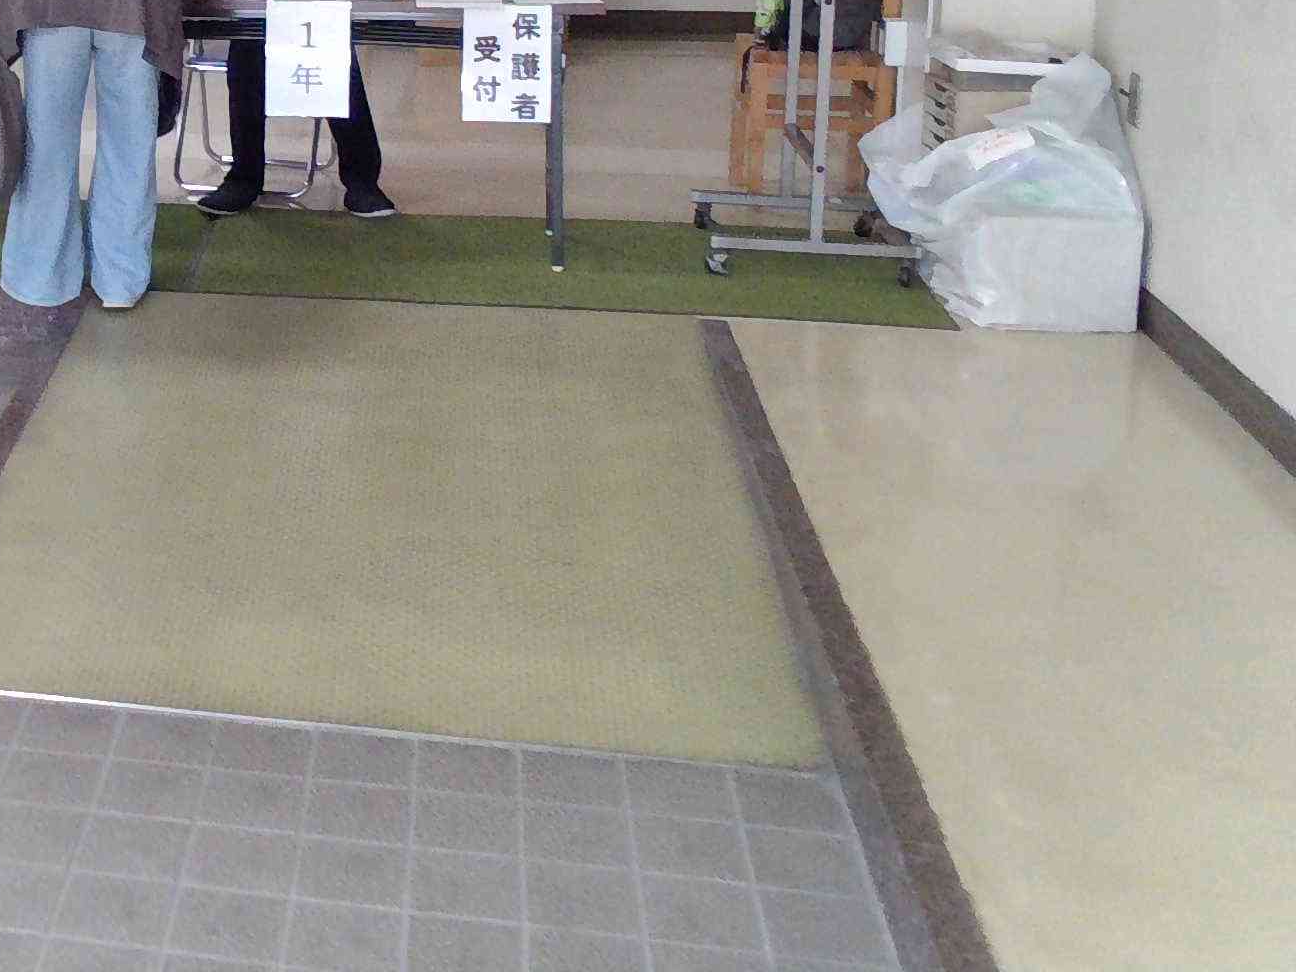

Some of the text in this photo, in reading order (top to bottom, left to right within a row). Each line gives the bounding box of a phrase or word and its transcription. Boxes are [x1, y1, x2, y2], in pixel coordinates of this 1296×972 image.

[287, 21, 323, 94] 1年
[472, 35, 501, 103] 受付
[511, 12, 541, 120] 保護者
